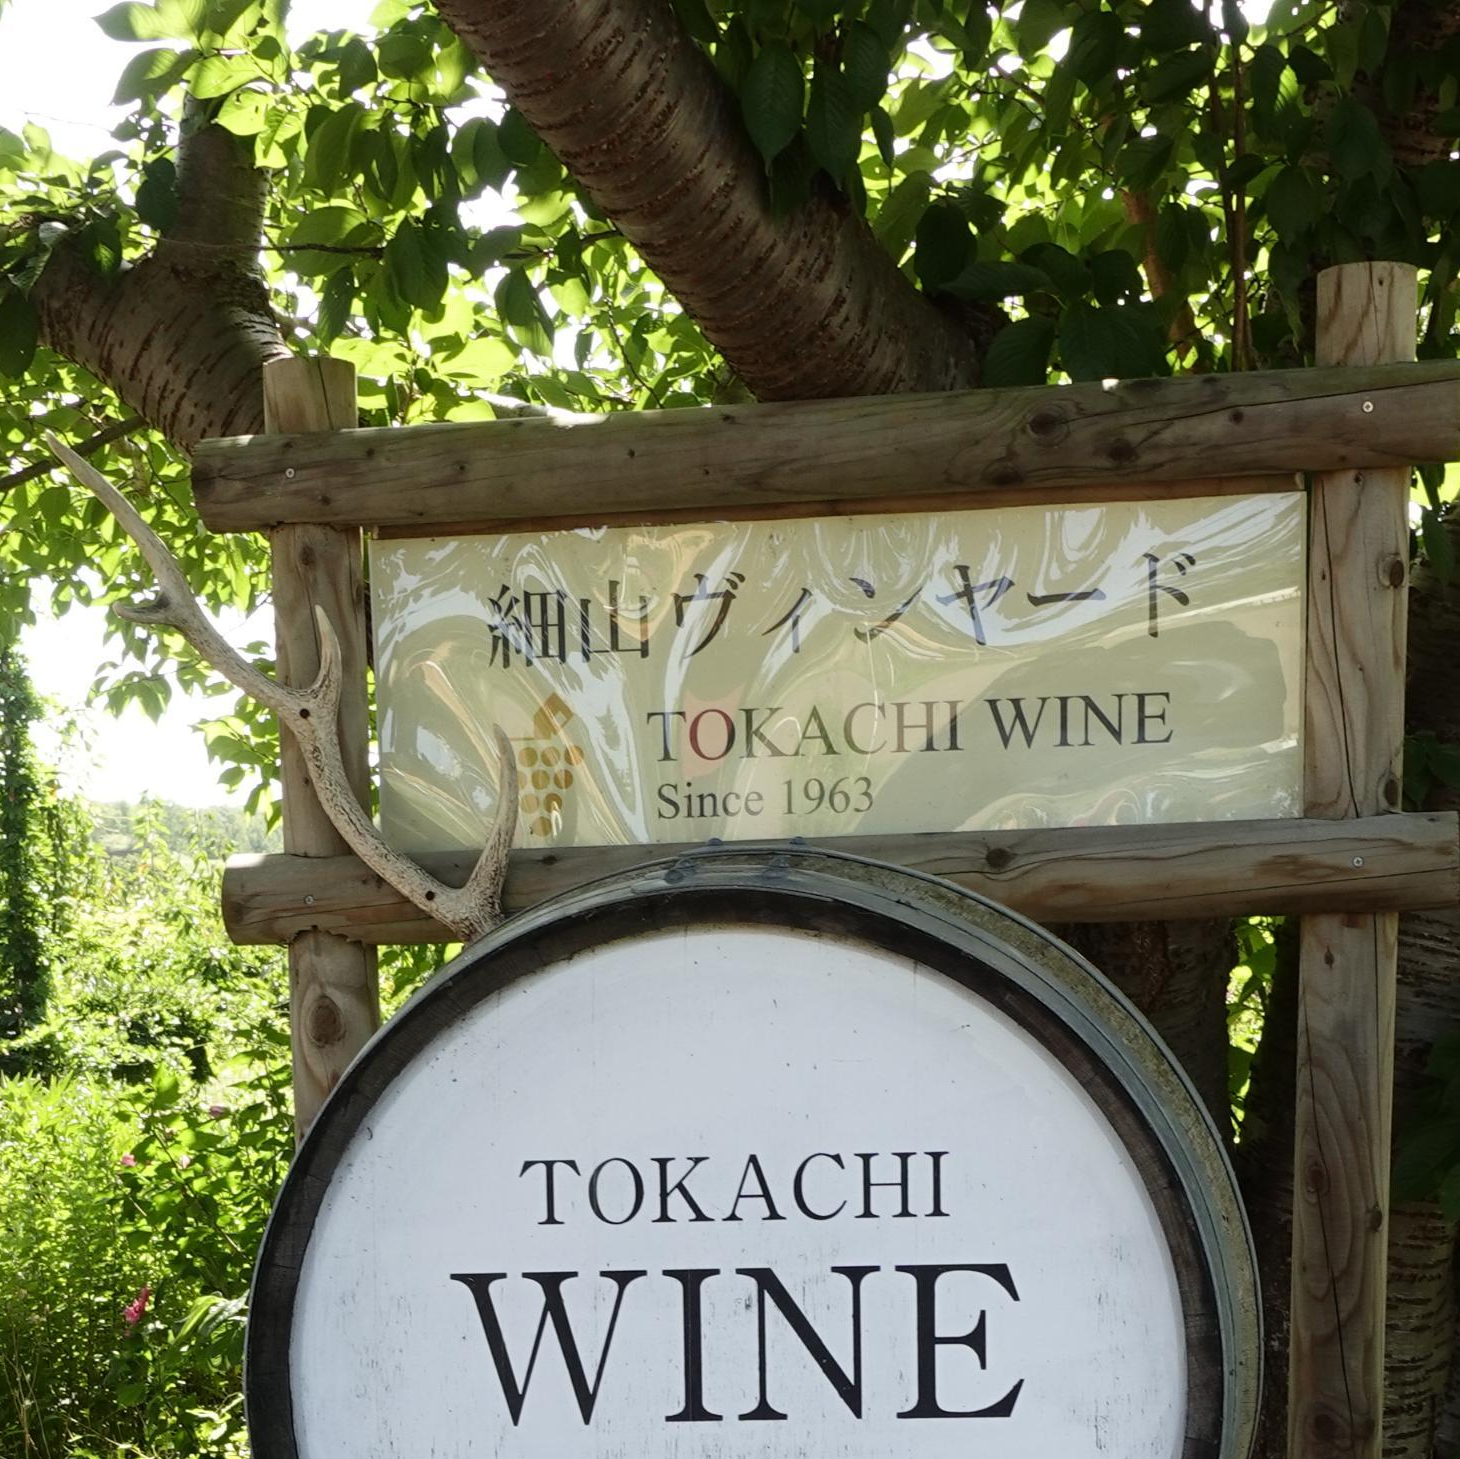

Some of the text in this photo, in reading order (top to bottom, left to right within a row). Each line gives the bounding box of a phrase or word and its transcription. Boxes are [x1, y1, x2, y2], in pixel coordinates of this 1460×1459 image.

[487, 553, 1197, 670] 細山ヴィンヤード
[646, 690, 1174, 763] TOKACHI WINE
[655, 776, 875, 822] Since 1963
[519, 1150, 951, 1226] TOKACHI
[449, 1262, 1025, 1427] WINE
